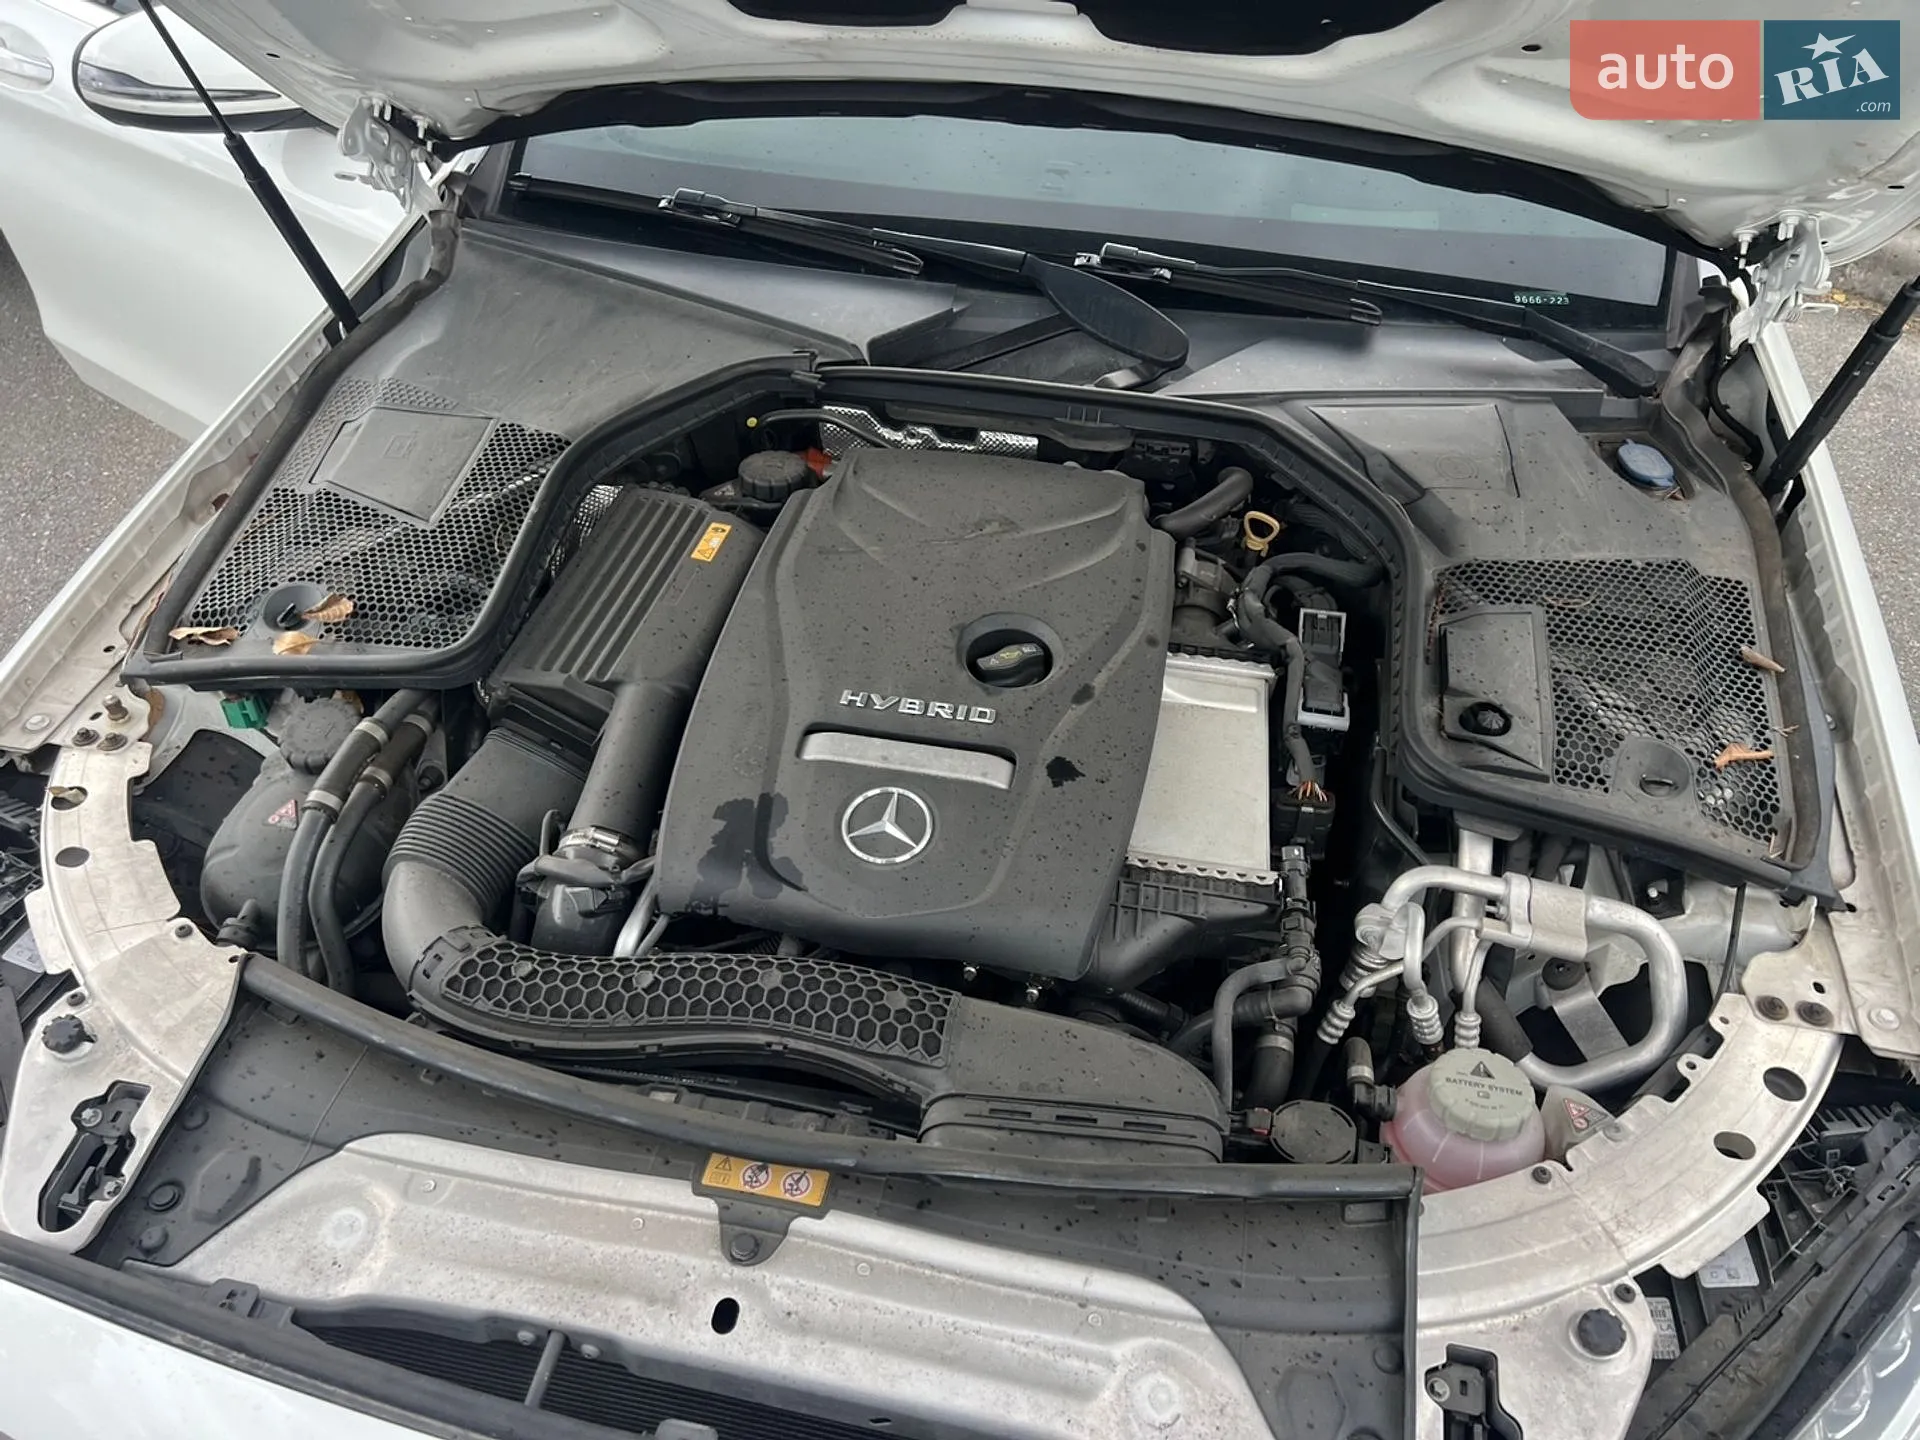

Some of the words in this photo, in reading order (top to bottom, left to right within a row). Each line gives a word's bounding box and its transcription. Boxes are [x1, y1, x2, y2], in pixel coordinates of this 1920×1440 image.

[839, 689, 997, 724] HYBRID
[1445, 1077, 1485, 1089] BATTERY
[1488, 1084, 1523, 1096] SYSTEM
